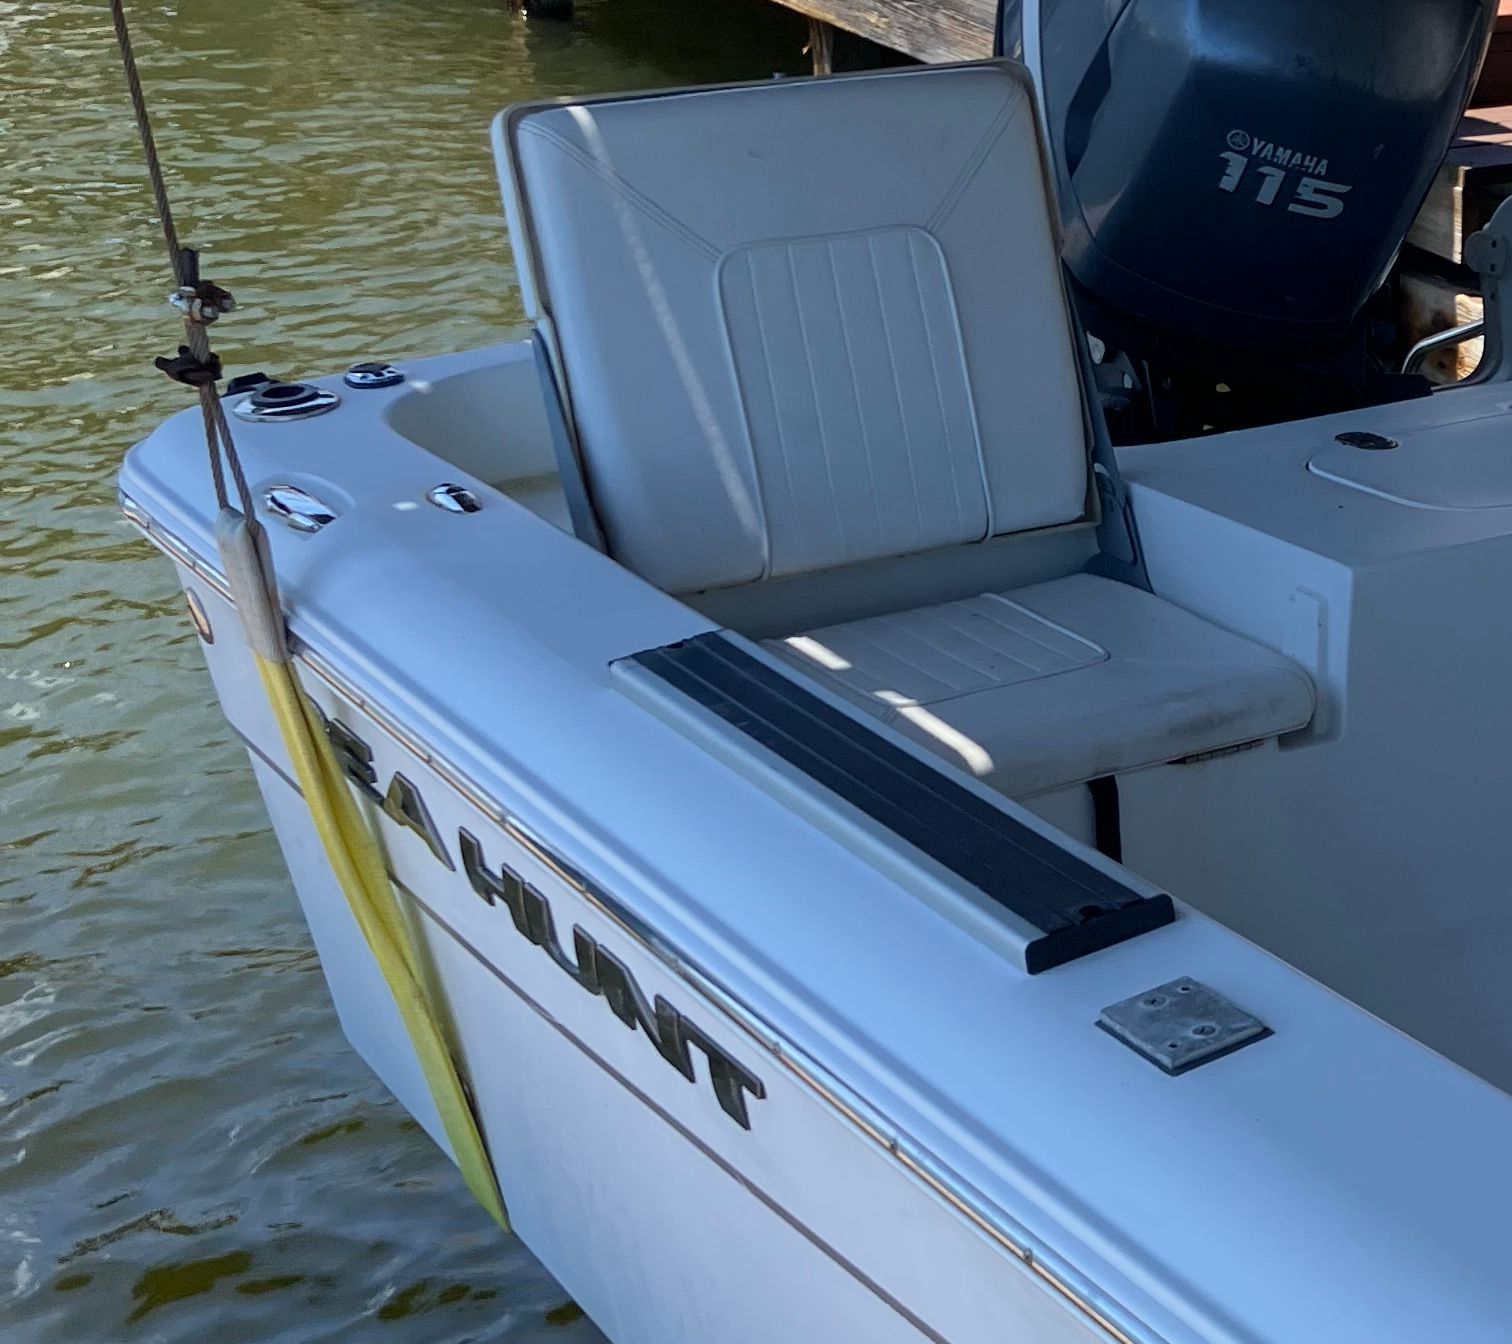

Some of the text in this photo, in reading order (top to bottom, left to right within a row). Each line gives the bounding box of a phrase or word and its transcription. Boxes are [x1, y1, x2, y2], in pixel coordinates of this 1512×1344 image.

[1218, 151, 1353, 219] 115
[1251, 137, 1329, 176] YAMAHA
[303, 692, 767, 1131] EA HUNT
